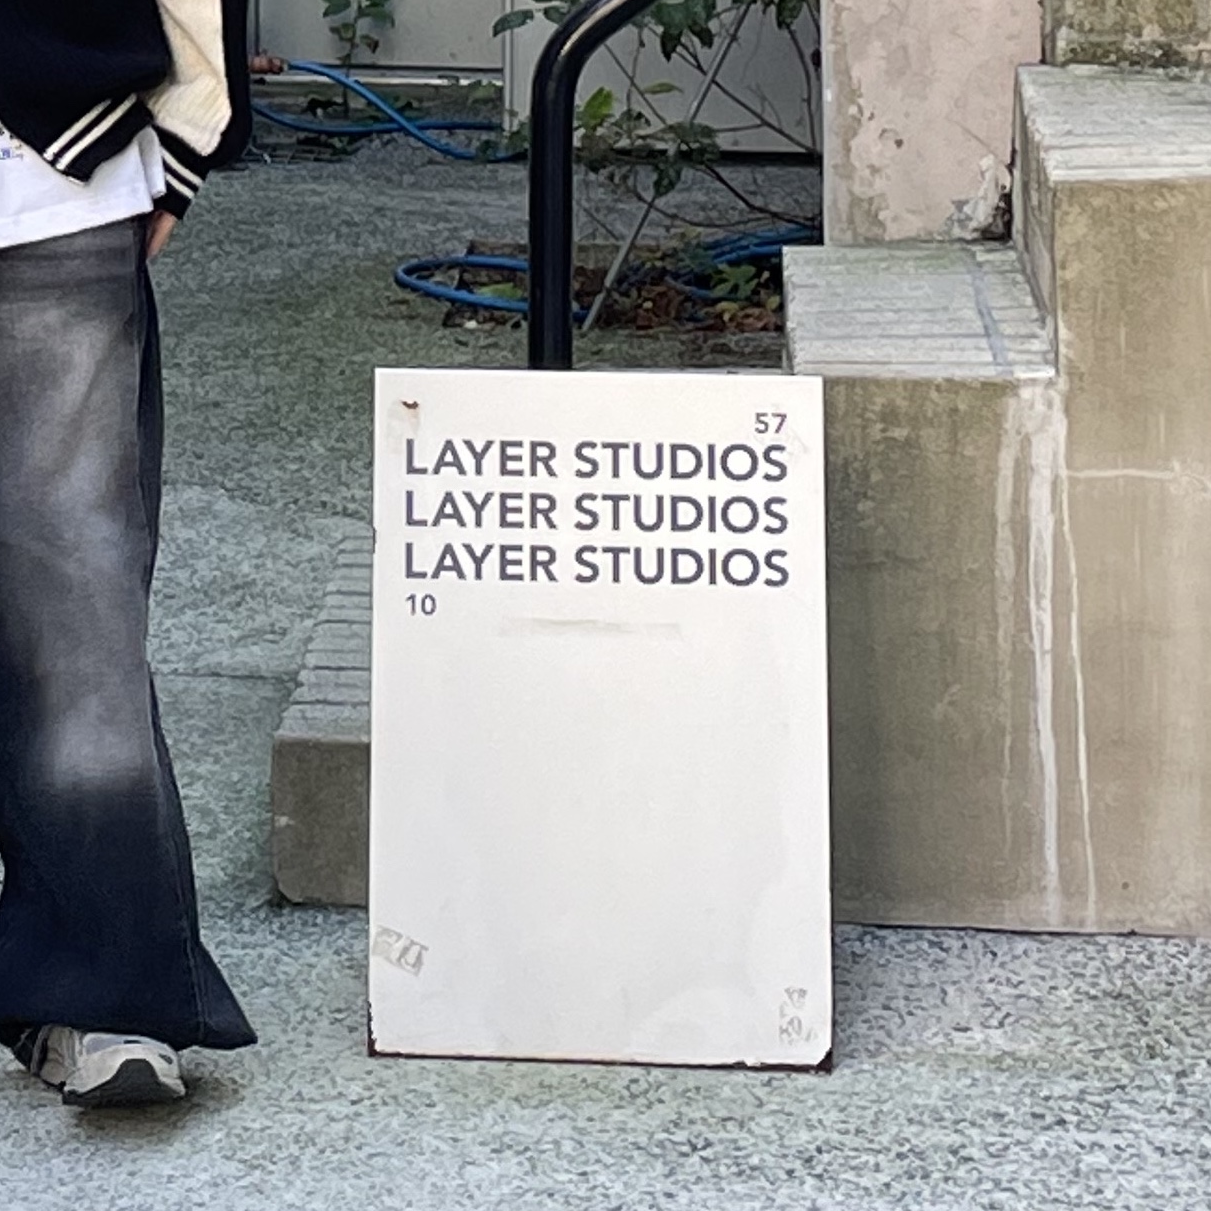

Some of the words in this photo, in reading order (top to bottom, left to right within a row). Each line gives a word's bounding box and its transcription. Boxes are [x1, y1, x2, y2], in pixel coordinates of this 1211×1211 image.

[754, 412, 787, 434] 57
[405, 438, 558, 478] LAYER
[574, 440, 788, 482] STUDIOS
[405, 490, 558, 530] LAYER
[574, 492, 789, 534] STUDIOS
[404, 542, 559, 583] LAYER
[574, 545, 789, 588] STUDIOS
[405, 593, 437, 616] 10
